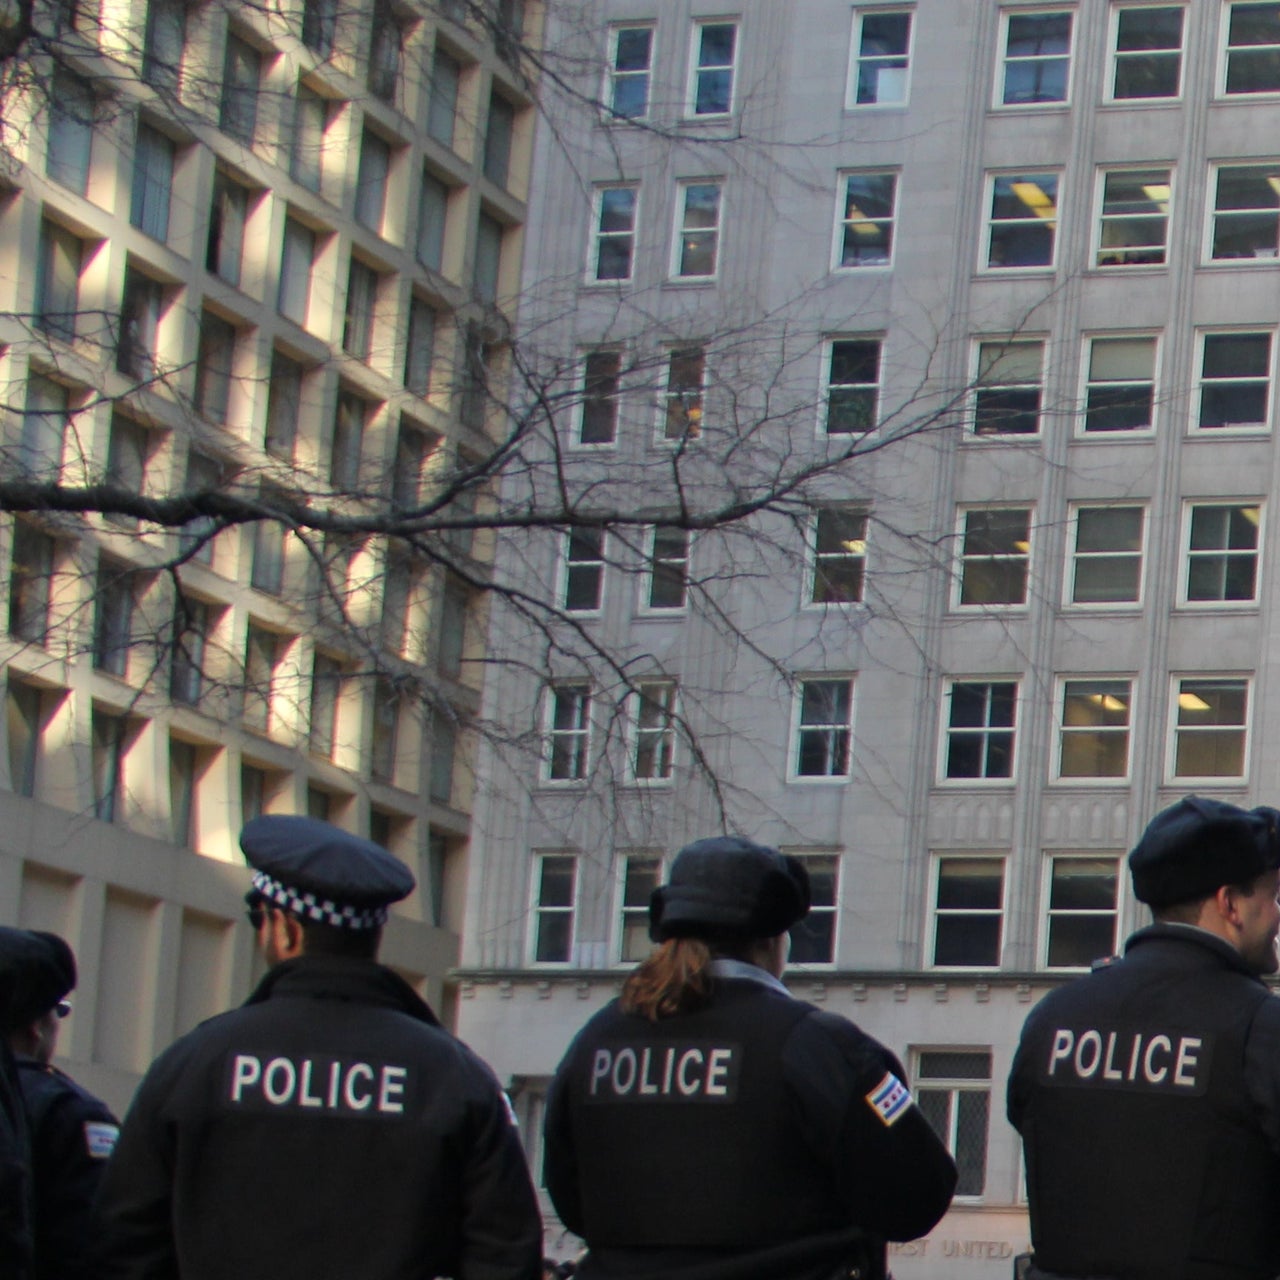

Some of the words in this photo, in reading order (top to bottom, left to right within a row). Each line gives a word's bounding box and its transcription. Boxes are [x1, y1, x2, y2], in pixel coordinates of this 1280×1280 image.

[230, 1053, 408, 1113] POLICE
[591, 1046, 733, 1097] POLICE
[1048, 1028, 1203, 1087] POLICE
[943, 1239, 1013, 1258] UNITED
